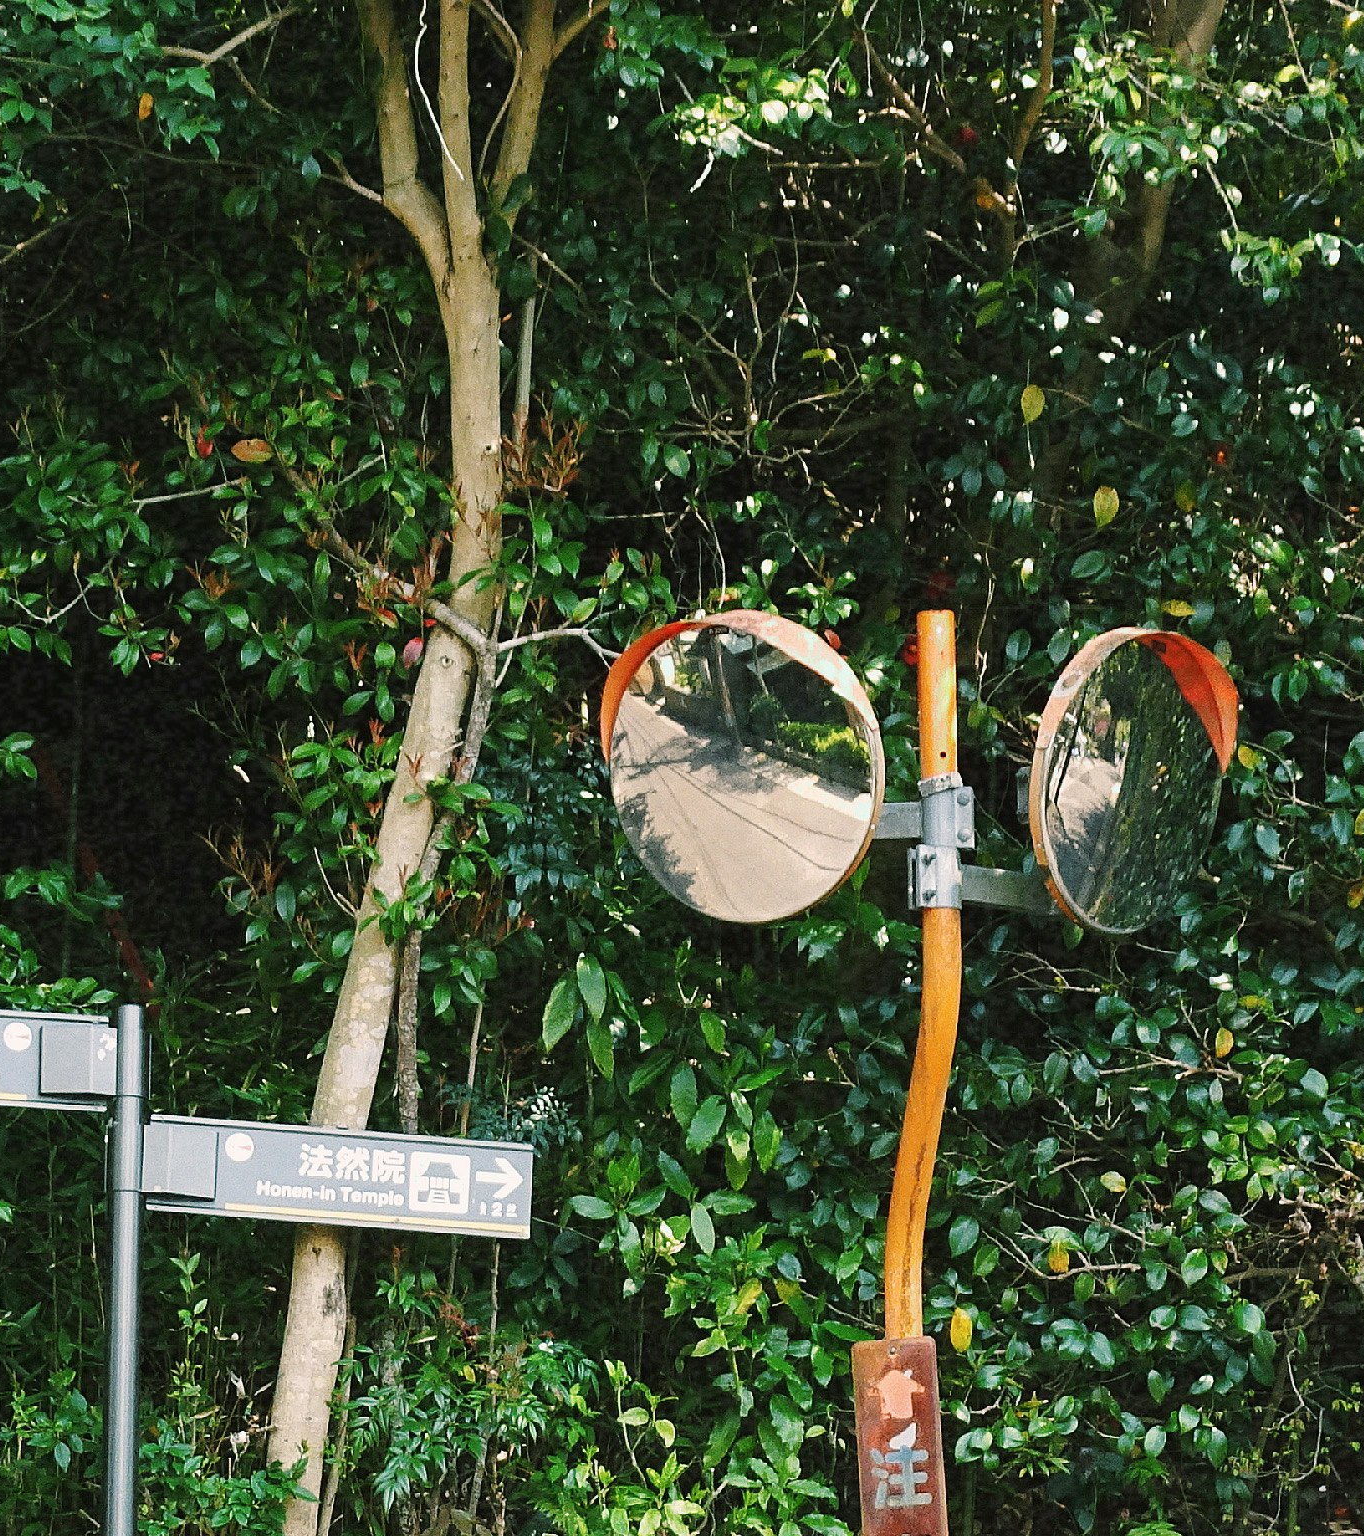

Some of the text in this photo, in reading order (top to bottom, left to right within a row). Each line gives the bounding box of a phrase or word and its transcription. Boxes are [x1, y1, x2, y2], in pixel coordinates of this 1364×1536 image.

[298, 1143, 406, 1185] 法然院
[255, 1179, 405, 1208] Honen-in Temple
